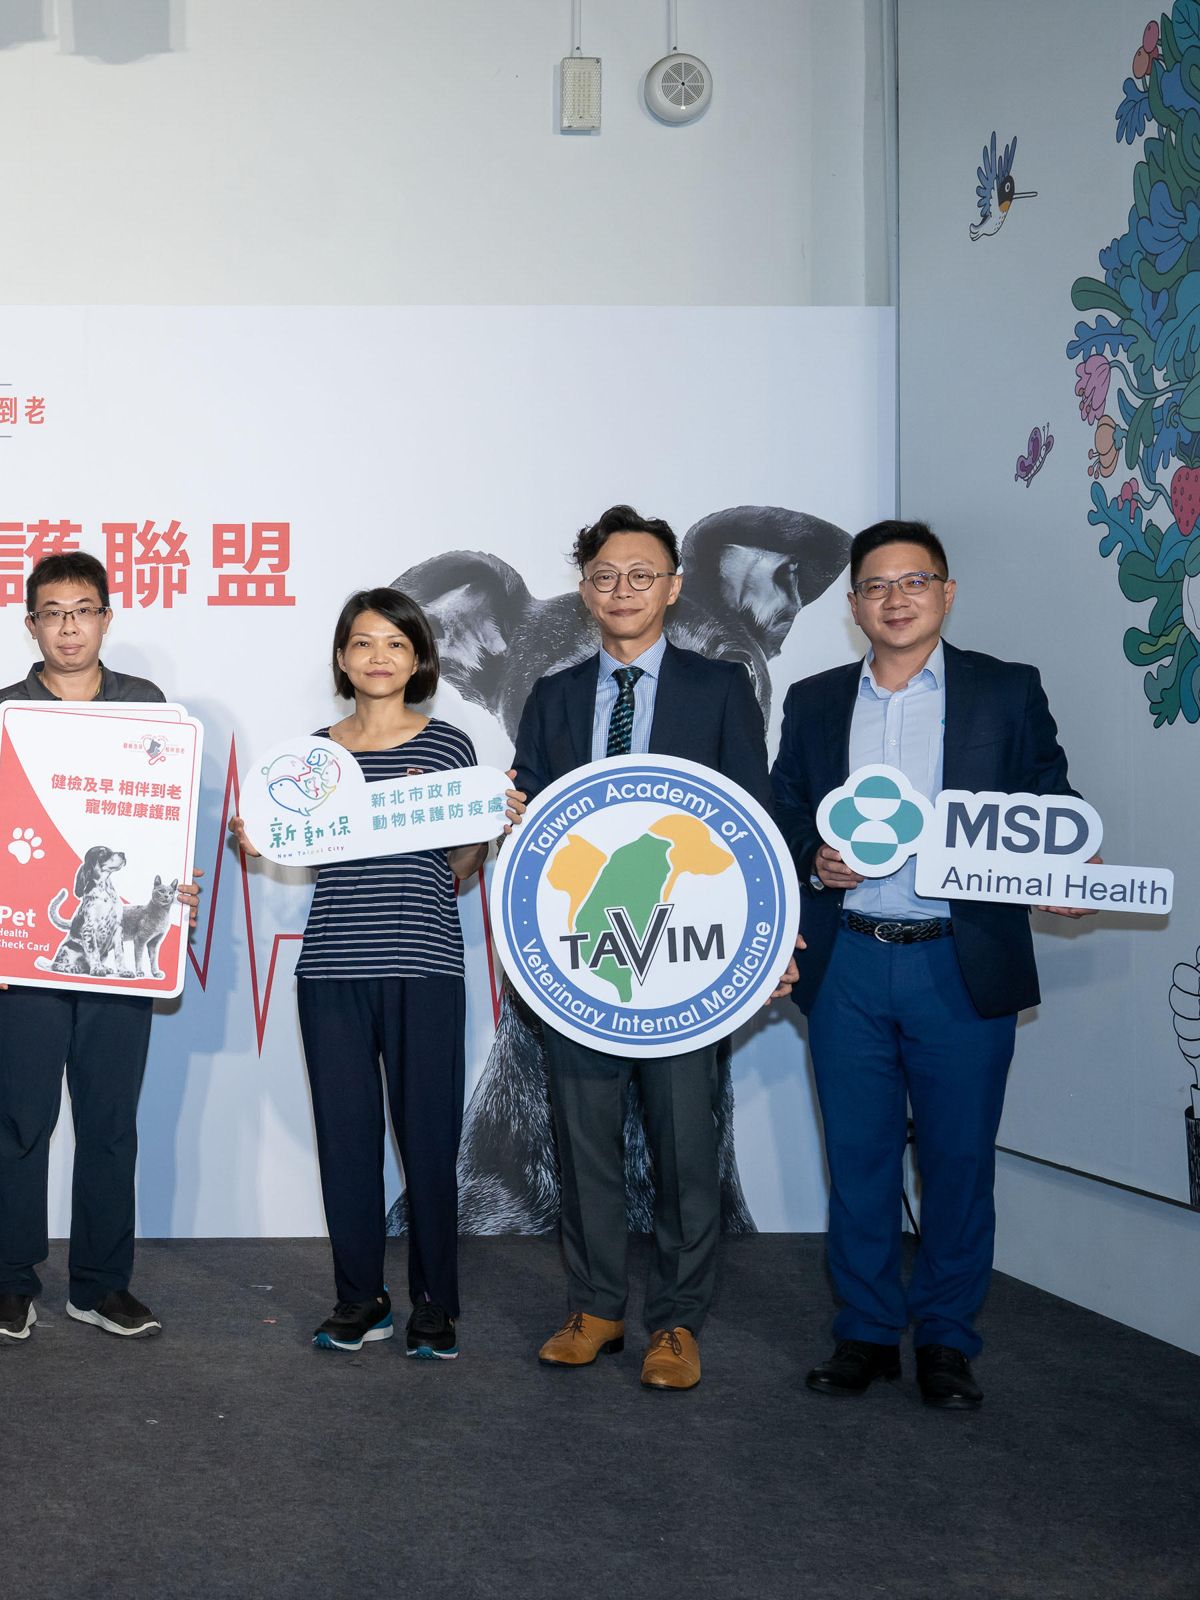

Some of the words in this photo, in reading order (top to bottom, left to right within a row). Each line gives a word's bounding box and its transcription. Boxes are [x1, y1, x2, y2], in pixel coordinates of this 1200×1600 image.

[51, 773, 114, 794] 健檢及早
[119, 779, 182, 800] 相伴到老
[371, 780, 463, 808] 新北市政府
[85, 798, 181, 822] 寵物健康護照
[372, 796, 504, 831] 動物保護防疫處
[527, 794, 595, 857] Taiwan
[605, 781, 720, 821] Academy
[720, 820, 749, 843] of
[269, 815, 351, 848] 新動保
[945, 801, 1089, 855] MSD
[941, 866, 1052, 896] Animal
[1064, 874, 1168, 906] Health
[26, 942, 50, 952] Card
[559, 903, 726, 987] TAVIM
[522, 938, 606, 1027] Veterinary
[612, 1004, 701, 1033] Internal
[702, 920, 772, 1016] Medicine
